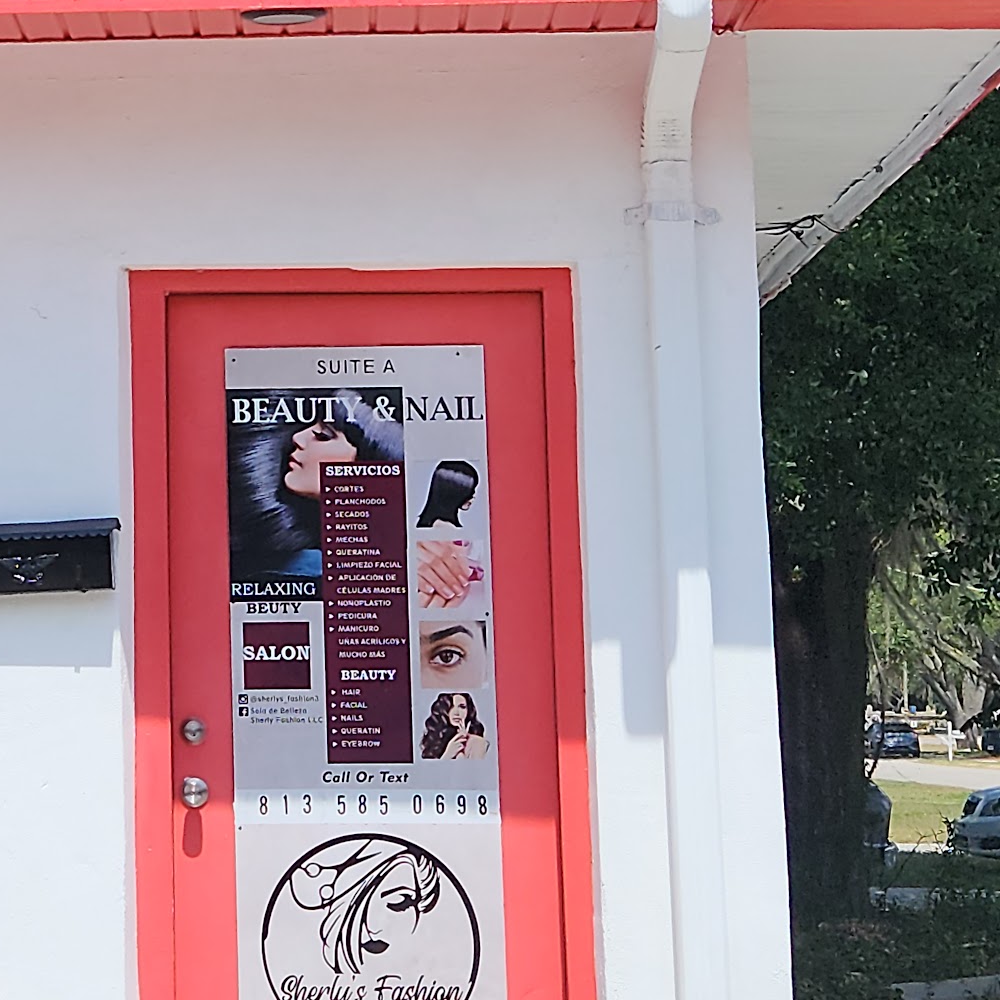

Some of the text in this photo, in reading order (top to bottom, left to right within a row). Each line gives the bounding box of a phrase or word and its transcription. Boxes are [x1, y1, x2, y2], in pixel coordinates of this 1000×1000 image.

[317, 359, 395, 374] SUITE A
[231, 396, 484, 424] BEAUTY & NAIL
[325, 465, 401, 477] SERVICIOS
[333, 485, 365, 493] CORTES
[334, 510, 370, 518] SECADOS
[335, 523, 368, 531] RAYITOS
[335, 548, 381, 556] QUERATINA
[374, 561, 403, 569] FACIAL
[385, 573, 397, 581] DE
[231, 582, 316, 596] RELAXING
[373, 586, 407, 594] MADRES
[246, 602, 302, 614] BEUTY
[337, 612, 378, 620] PEDICURA
[243, 645, 311, 661] SALON
[338, 651, 368, 659] MUCHO
[340, 669, 397, 681] BEAUTY
[341, 688, 361, 696] HAIR
[340, 701, 368, 709] FACIAL
[269, 707, 278, 715] de
[340, 714, 364, 722] NAILS
[340, 727, 381, 735] QUERATIN
[341, 740, 381, 748] EYEBROW
[322, 771, 409, 783] Call Or Text
[374, 974, 464, 1000] Fashion
